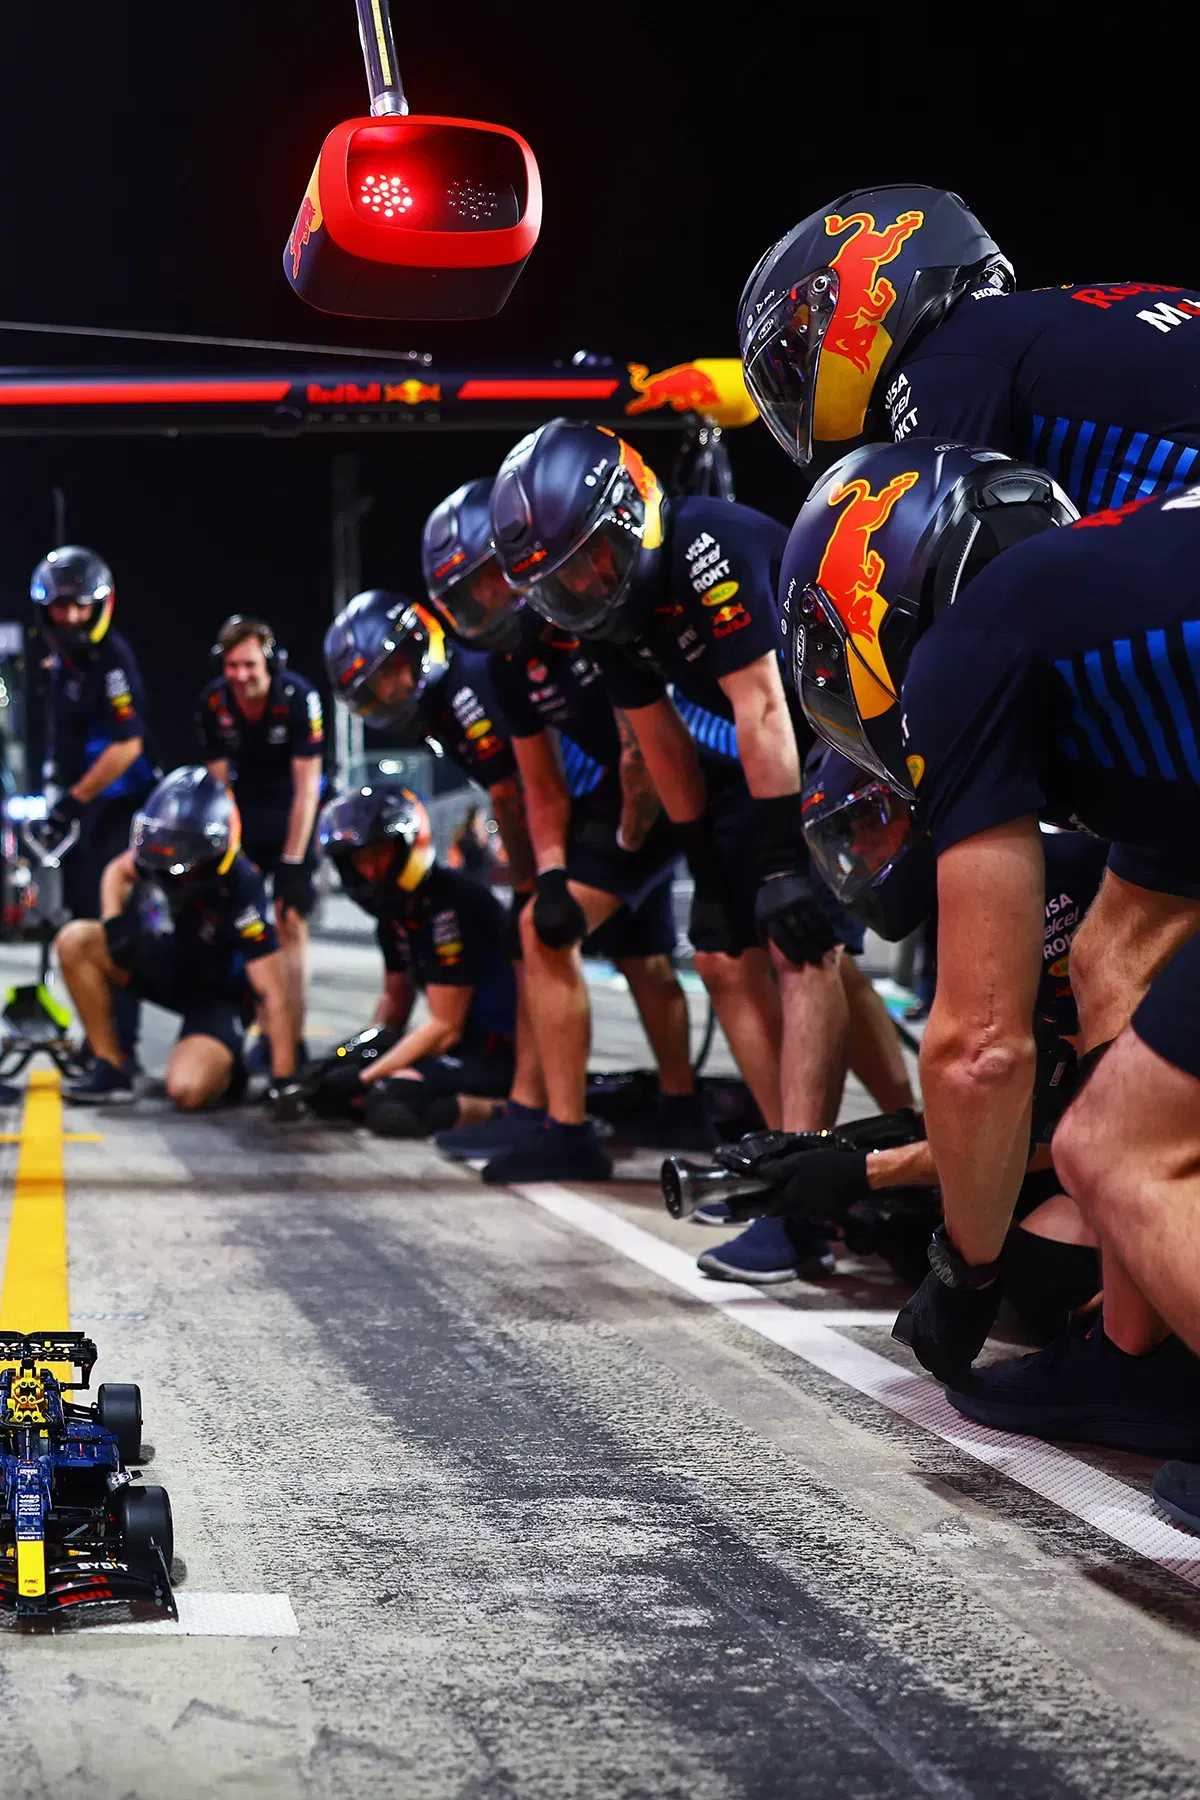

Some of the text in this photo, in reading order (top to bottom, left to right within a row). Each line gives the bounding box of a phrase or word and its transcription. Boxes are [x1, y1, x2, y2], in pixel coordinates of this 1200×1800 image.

[971, 288, 1009, 300] HON
[894, 407, 919, 443] OKT
[1045, 893, 1073, 918] ISA
[1044, 906, 1080, 939] elcel
